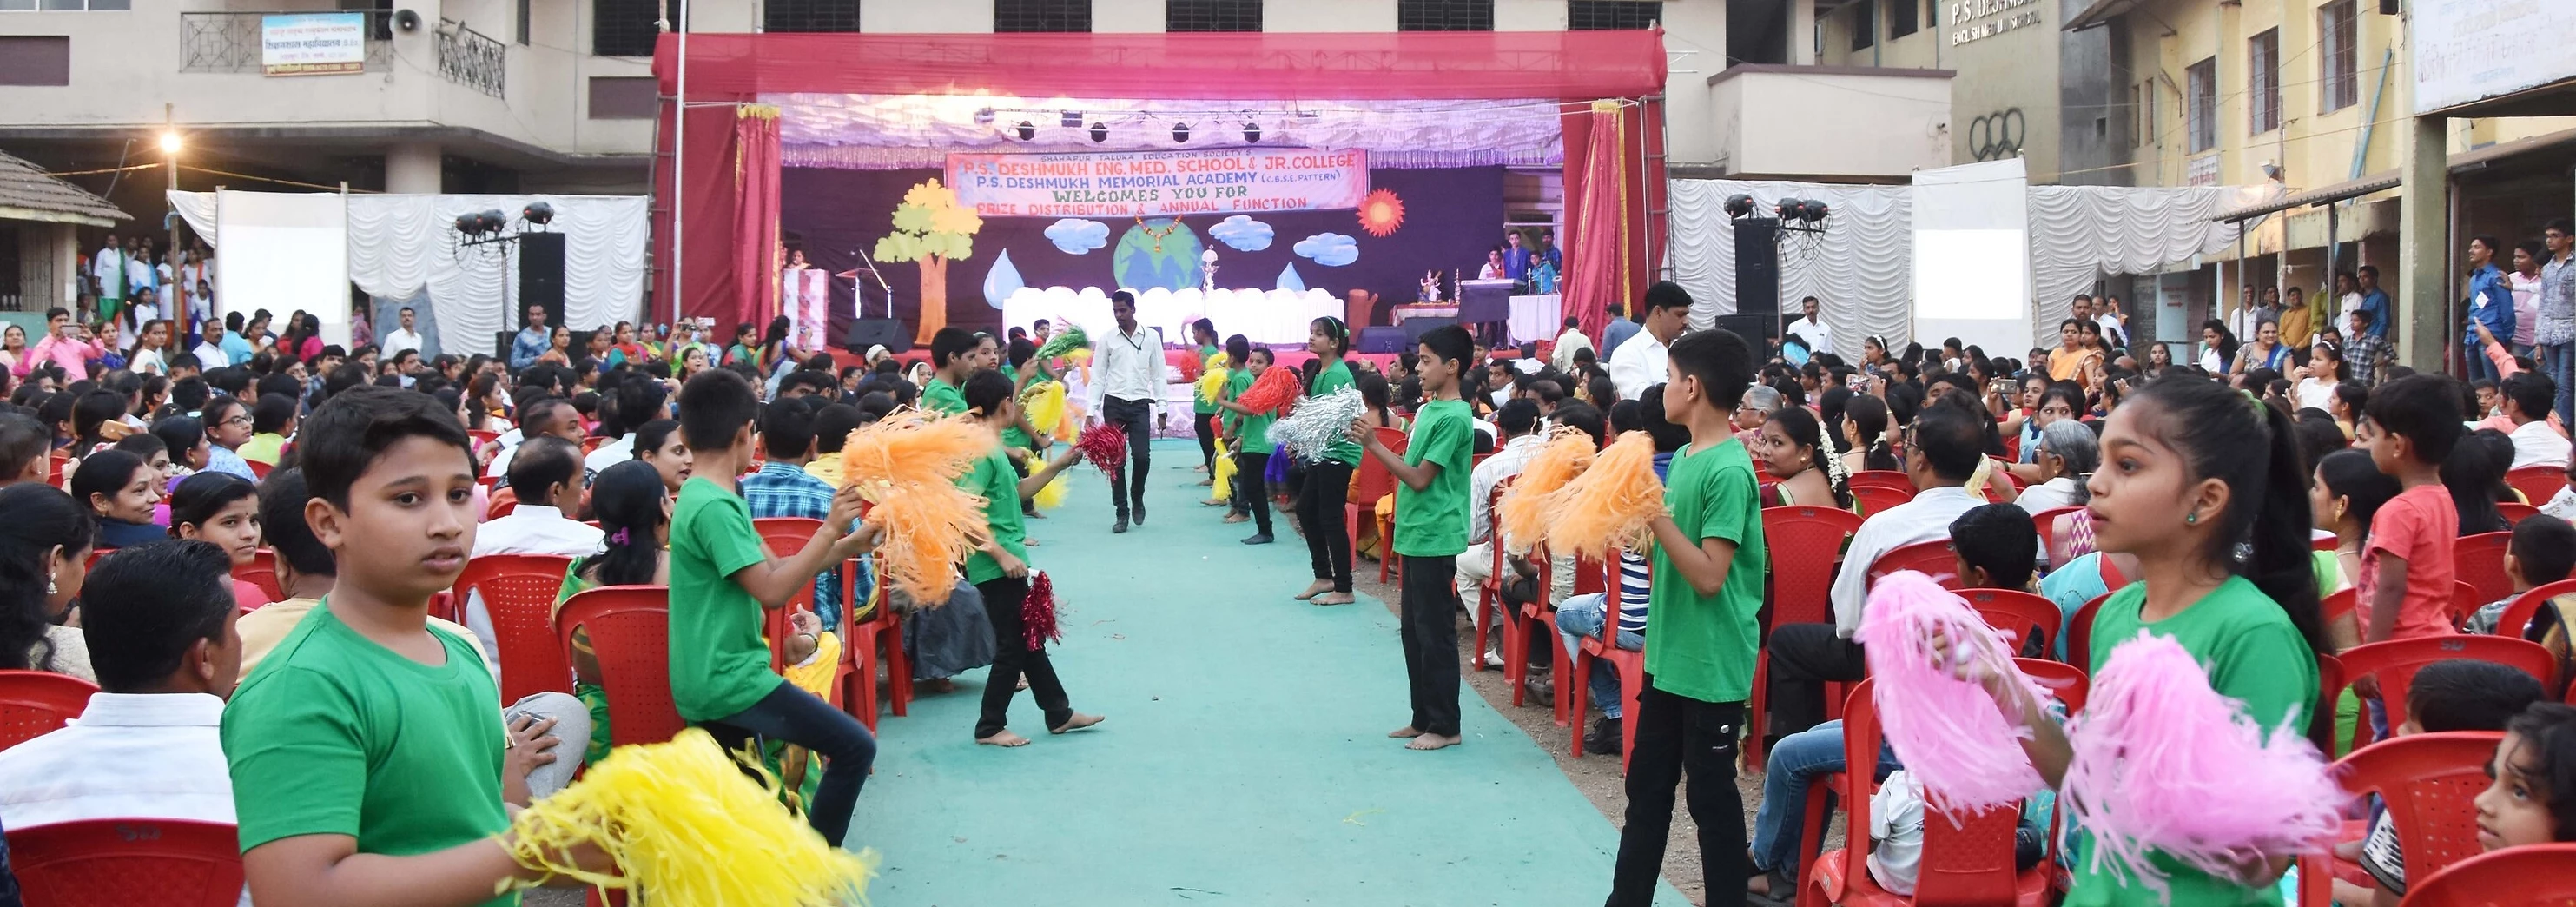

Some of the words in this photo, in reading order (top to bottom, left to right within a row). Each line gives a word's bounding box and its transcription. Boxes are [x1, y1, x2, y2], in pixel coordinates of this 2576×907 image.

[1143, 151, 1197, 160] EDUCATION
[1203, 149, 1252, 158] SOCIETY'S
[999, 162, 1088, 175] DESHMUKH
[1177, 157, 1245, 172] SCHOOL
[1248, 157, 1257, 169] &
[1292, 154, 1355, 169] COLLEGE
[1007, 177, 1089, 189] DESHMUKH
[1099, 175, 1180, 188] MEMORIAL
[1186, 172, 1257, 185] ACADEMY
[1052, 189, 1159, 202] WELCOMES
[1171, 186, 1208, 199] YOU
[1216, 185, 1248, 198] FOR
[976, 203, 1017, 215] PRIZE
[1028, 204, 1128, 216] DISTRIBUTION
[1136, 203, 1146, 215] &
[1159, 200, 1219, 213] ANNUAL
[1232, 197, 1307, 210] FUNCTION
